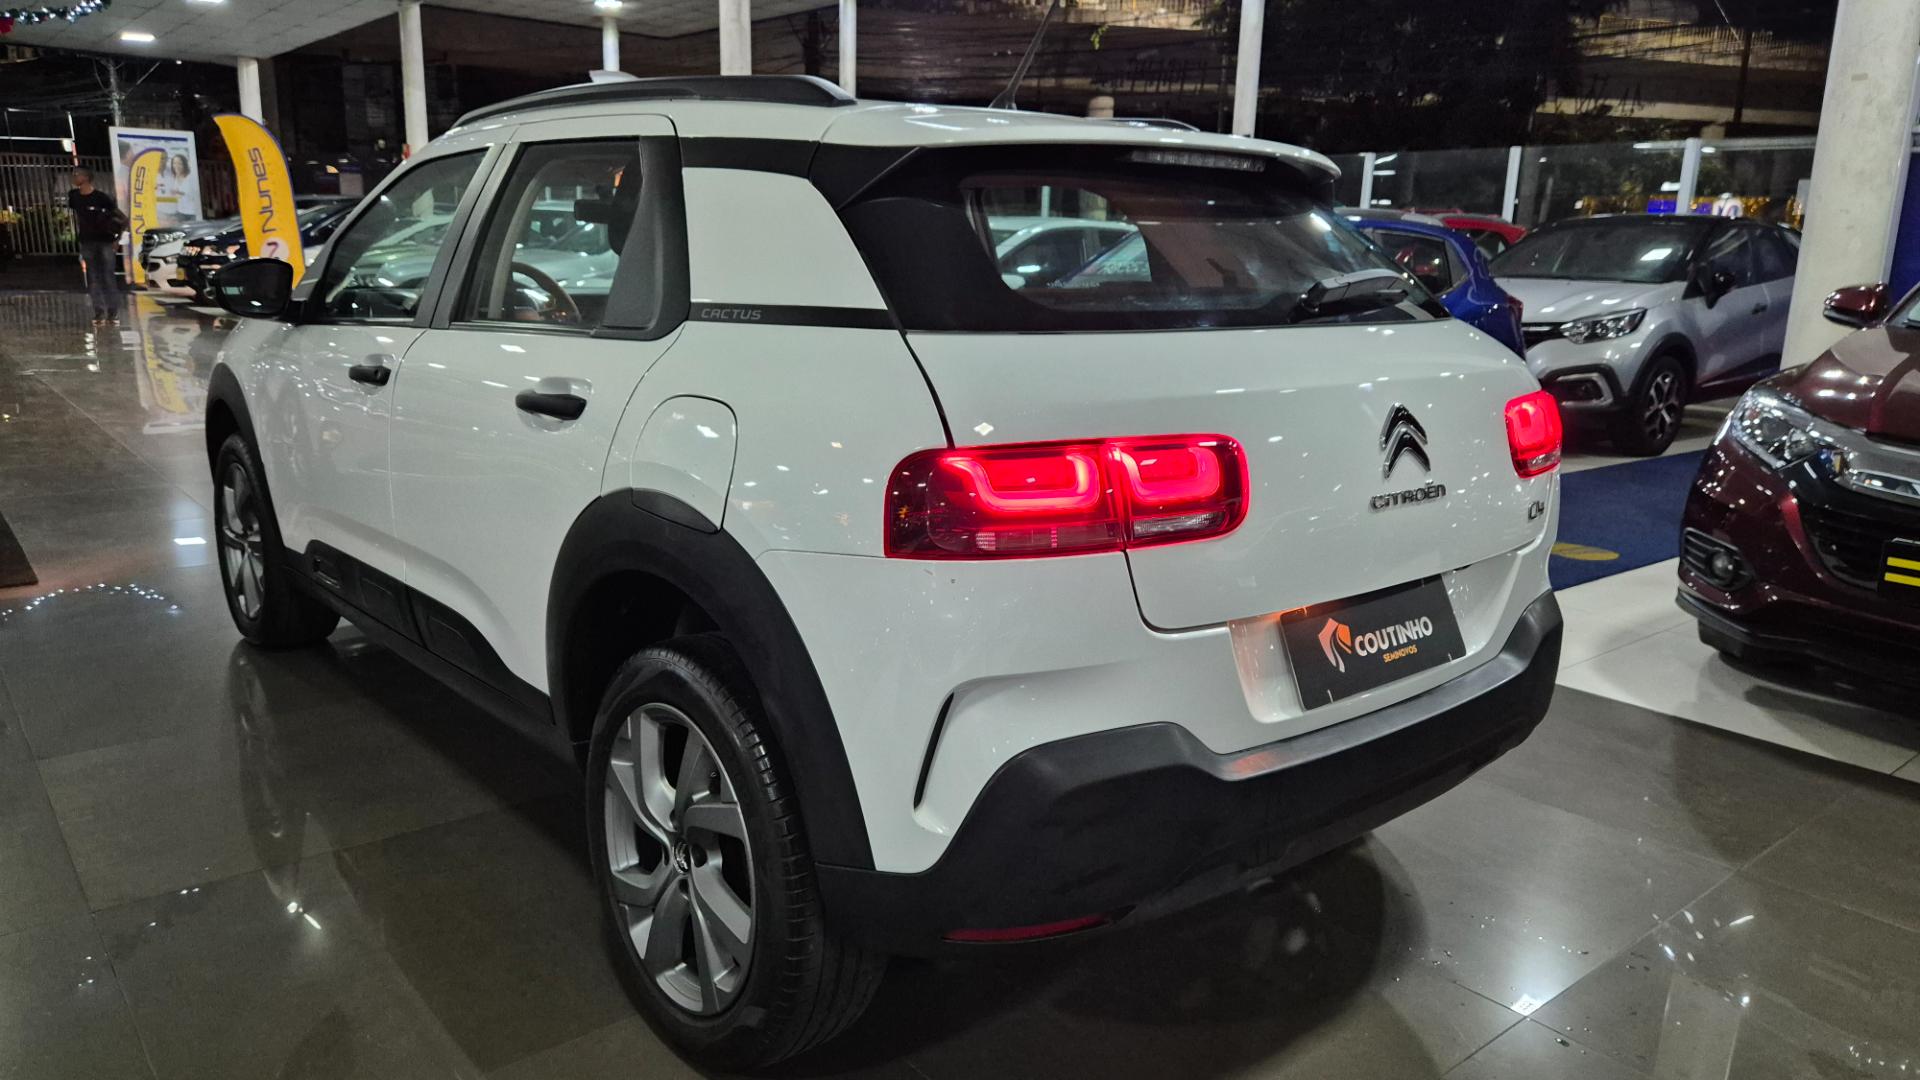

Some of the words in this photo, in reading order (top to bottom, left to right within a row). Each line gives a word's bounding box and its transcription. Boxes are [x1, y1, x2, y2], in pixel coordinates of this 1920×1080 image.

[248, 147, 277, 234] Nunes
[701, 308, 762, 320] CACTUS
[1528, 501, 1545, 520] C4
[1354, 616, 1433, 657] COUTINHO
